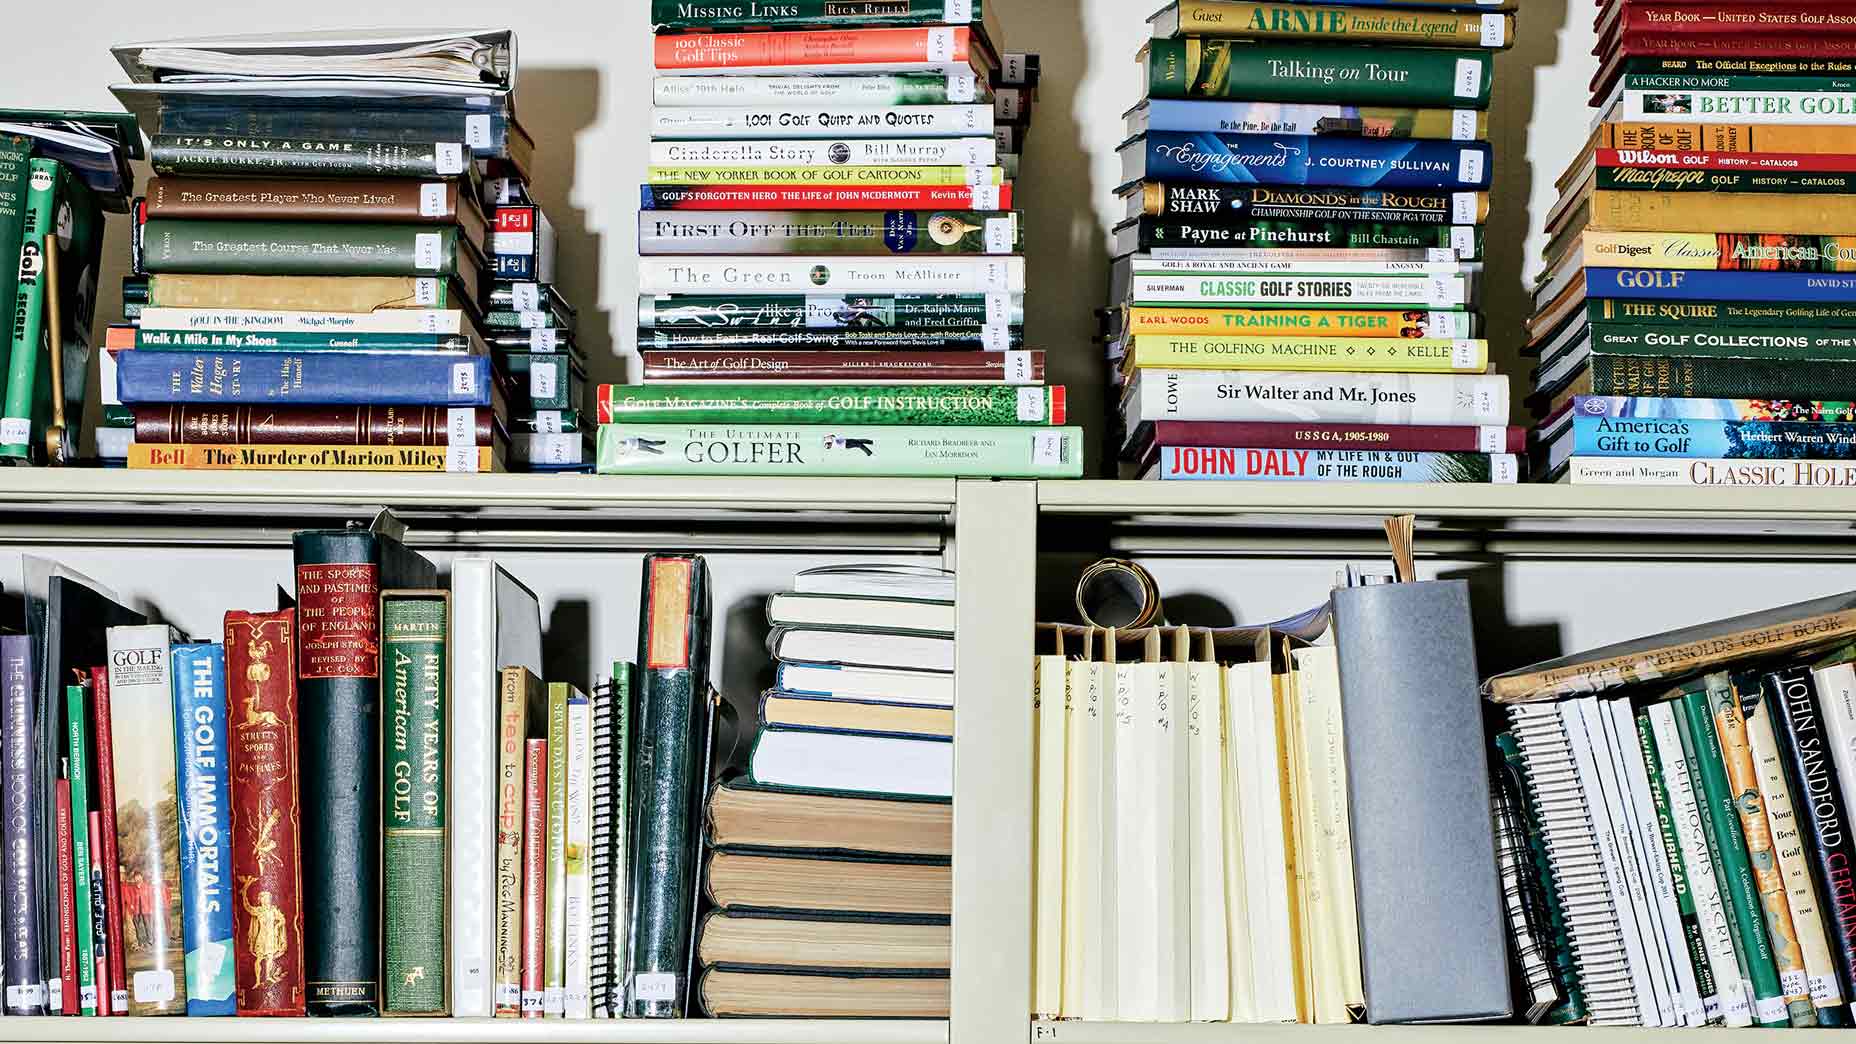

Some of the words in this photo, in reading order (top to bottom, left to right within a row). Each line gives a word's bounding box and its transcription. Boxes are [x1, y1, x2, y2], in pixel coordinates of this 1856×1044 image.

[677, 3, 743, 18] MISSING
[751, 2, 798, 17] LINKS
[827, 4, 856, 15] RICK
[864, 4, 908, 14] REILLY
[675, 39, 696, 49] 100
[697, 35, 745, 48] Classic
[675, 48, 705, 63] Golf
[710, 48, 738, 64] Tips
[1268, 59, 1335, 84] Talking
[1339, 68, 1360, 80] on
[1364, 63, 1409, 81] Tour
[1632, 77, 1639, 86] A
[1641, 77, 1680, 87] HACKER
[1682, 77, 1699, 87] NO
[1701, 78, 1729, 87] MORE
[745, 114, 772, 128] 1,001
[778, 113, 811, 126] GOLF
[818, 112, 854, 127] QUIPS
[858, 113, 880, 125] AND
[885, 112, 934, 126] QUOTES
[176, 138, 213, 146] IT'S
[224, 140, 271, 148] ONLY
[302, 143, 352, 151] GAME
[1623, 130, 1637, 146] THE
[1641, 127, 1655, 150] BOOK
[1659, 132, 1673, 145] OF
[1677, 128, 1692, 150] GOLF
[668, 145, 762, 160] Cinderella
[769, 145, 815, 164] Story
[865, 143, 889, 156] Bill
[897, 143, 946, 159] Murray
[1156, 142, 1300, 171] Engagements
[1617, 150, 1680, 164] Wilson
[1683, 155, 1709, 165] GOLF
[1718, 158, 1749, 166] HISTORY
[1760, 159, 1798, 167] CATALOGS
[1304, 157, 1314, 166] J.
[1319, 157, 1386, 169] COURTNEY
[1390, 160, 1450, 171] SULLIVAN
[657, 170, 680, 180] THE
[684, 170, 711, 180] NEW
[715, 170, 761, 180] YORKER
[764, 170, 797, 180] BOOK
[802, 170, 818, 180] OF
[823, 170, 854, 180] GOLF
[858, 170, 922, 180] CARTOONS
[1612, 167, 1705, 190] MacGregor
[1711, 175, 1740, 185] GOLF
[1801, 178, 1846, 186] CATALOGS
[181, 192, 202, 201] The
[205, 193, 257, 201] Greatest
[260, 193, 299, 204] Player
[302, 194, 323, 203] Who
[328, 194, 360, 203] Never
[363, 195, 394, 204] Lived
[931, 190, 956, 200] Kevin
[1170, 188, 1221, 200] MARK
[1251, 188, 1347, 205] DIAMONDS
[1350, 195, 1359, 204] in
[1360, 194, 1379, 205] the
[1381, 192, 1447, 208] ROUGH
[1170, 200, 1221, 213] SHAW
[1181, 225, 1230, 243] Payne
[1234, 232, 1247, 240] at
[1250, 227, 1331, 242] Pinehurst
[1351, 233, 1370, 244] Bill
[1373, 234, 1419, 245] Chastain
[668, 266, 711, 283] The
[723, 267, 792, 283] Green
[848, 270, 886, 280] Troon
[896, 269, 961, 281] McAllister
[1616, 271, 1686, 288] GOLF
[1147, 284, 1185, 292] SILVERMAN
[1200, 280, 1256, 297] CLASSIC
[1260, 281, 1292, 297] GOLF
[1297, 281, 1352, 297] STORIES
[1807, 278, 1839, 288] DAVID
[1140, 316, 1167, 324] EARL
[1171, 316, 1209, 324] WOODS
[142, 332, 169, 344] Walk
[173, 333, 183, 344] A
[186, 333, 208, 345] Mile
[211, 334, 222, 345] In
[225, 334, 242, 347] My
[245, 334, 278, 346] Shoes
[1169, 342, 1198, 353] THE
[1204, 343, 1265, 354] GOLFING
[1272, 344, 1337, 355] MACHINE
[664, 358, 685, 369] The
[689, 358, 708, 369] Art
[711, 358, 721, 371] of
[723, 357, 747, 369] Golf
[751, 358, 789, 373] Design
[172, 371, 181, 393] THE
[191, 359, 204, 394] Walter
[1167, 373, 1178, 413] LOWE
[1217, 384, 1242, 399] Sir
[1245, 385, 1300, 400] Walter
[1303, 387, 1333, 400] and
[1339, 387, 1367, 401] Mr.
[1371, 388, 1416, 405] Jones
[1596, 417, 1689, 434] America's
[1344, 432, 1389, 441] 1905-1980
[1597, 436, 1630, 451] Gift
[1634, 440, 1649, 452] to
[1655, 437, 1691, 453] Golf
[1740, 431, 1783, 443] Herbert
[1784, 432, 1824, 444] Warren
[1826, 433, 1856, 444] Wind
[150, 447, 184, 465] Bell
[204, 449, 236, 465] The
[240, 449, 307, 465] Murder
[310, 449, 331, 465] of
[332, 449, 395, 465] Marion
[400, 450, 446, 469] Miley
[684, 441, 805, 464] GOLFER
[1171, 447, 1235, 475] JOHN
[1246, 450, 1310, 476] DALY
[1690, 461, 1785, 486] CLASSIC
[303, 570, 324, 580] THE
[327, 569, 371, 579] SPORTS
[300, 584, 321, 593] AND
[324, 583, 379, 593] PASTIMES
[304, 607, 325, 617] THE
[332, 607, 375, 617] PEOPLE
[302, 622, 317, 632] OF
[322, 621, 376, 631] ENGLAND
[113, 649, 162, 667] GOLF
[191, 656, 213, 699] THE
[423, 653, 440, 710] FIFTY
[394, 649, 413, 752] American
[194, 706, 216, 768] GOLF
[244, 743, 274, 752] SPORTS
[423, 720, 440, 784] YEARS
[1781, 676, 1817, 733] JOHN
[1800, 737, 1842, 848] SANDFORD
[394, 760, 412, 823] GOLF
[424, 791, 439, 817] OF
[1772, 810, 1792, 821] Your
[1776, 829, 1798, 840] Best
[198, 775, 220, 913] IMMORTALS
[1675, 759, 1692, 793] BEN
[1709, 891, 1734, 958] SECRET
[1782, 846, 1801, 859] Golf
[1825, 850, 1855, 937] CERTAIN
[316, 987, 365, 997] METHUEN
